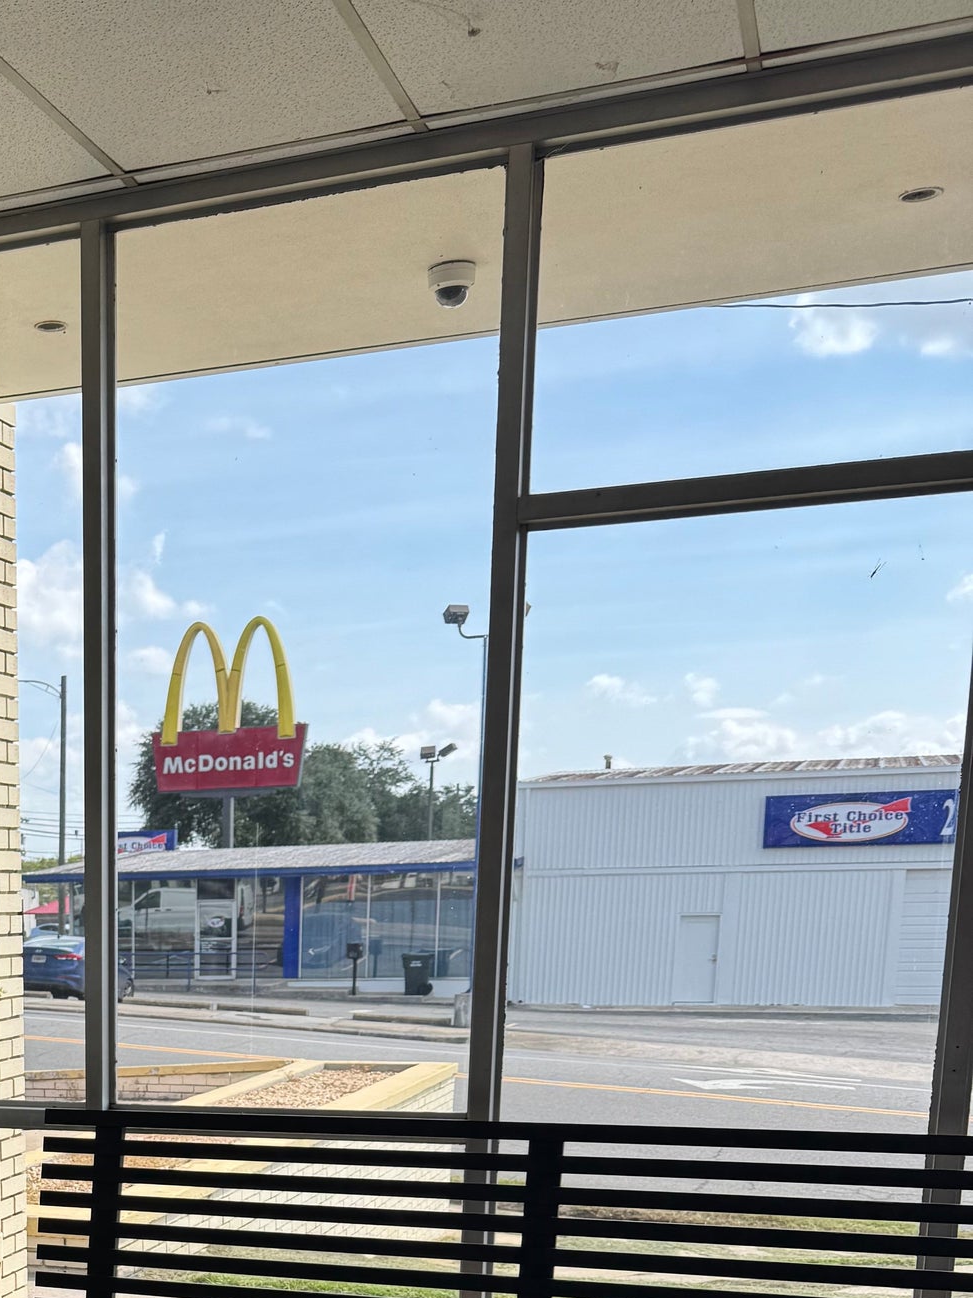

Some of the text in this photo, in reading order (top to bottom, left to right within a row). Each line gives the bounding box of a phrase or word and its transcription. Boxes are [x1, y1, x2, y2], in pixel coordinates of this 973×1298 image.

[162, 750, 295, 775] McDonald's
[796, 809, 905, 823] First Choice
[830, 822, 872, 835] Title
[131, 841, 163, 850] Choice
